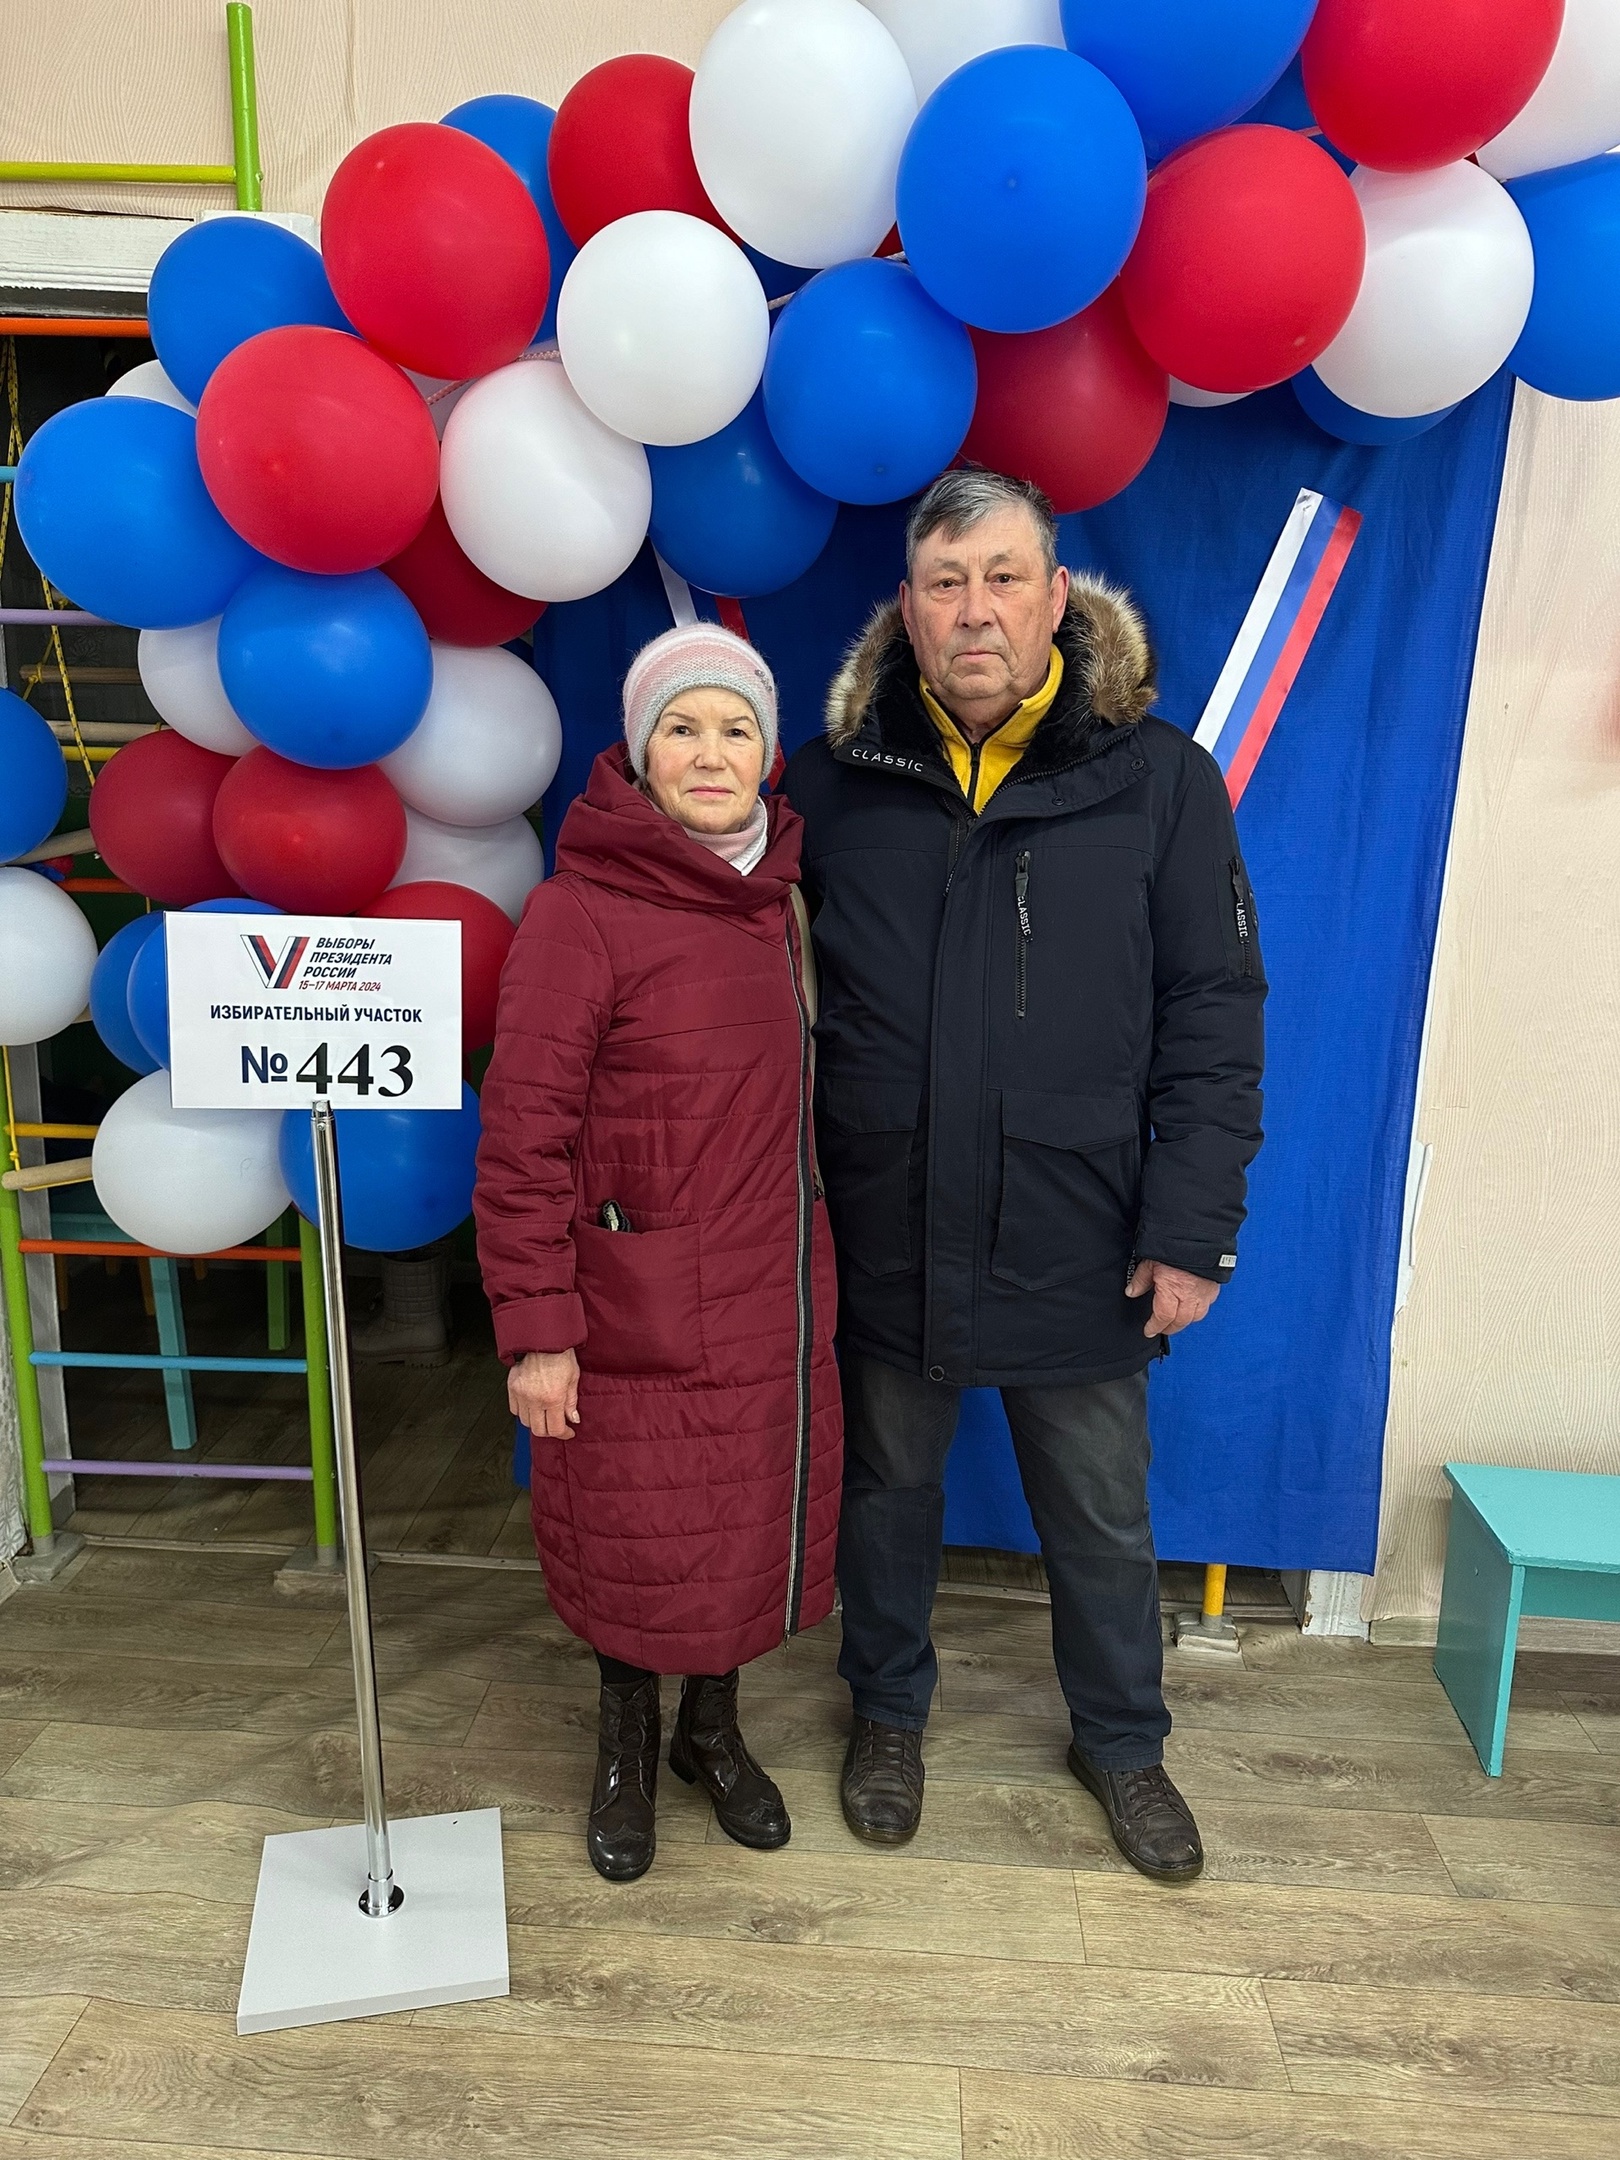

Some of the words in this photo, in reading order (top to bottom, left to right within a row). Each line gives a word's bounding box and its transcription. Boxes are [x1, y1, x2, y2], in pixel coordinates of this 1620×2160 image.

[851, 748, 924, 772] CLASSIC
[1017, 895, 1031, 936] CLASSIC
[316, 937, 376, 950] ВЫБОРЫ
[309, 951, 392, 966] ПРЕЗИДЕНТА
[303, 966, 357, 978] РОССИИ
[325, 981, 357, 991] МАРТА
[358, 982, 381, 992] 2024
[210, 1004, 350, 1021] ИЗБИРАТЕЛЬНЫЙ
[354, 1008, 422, 1022] УЧАСТОК
